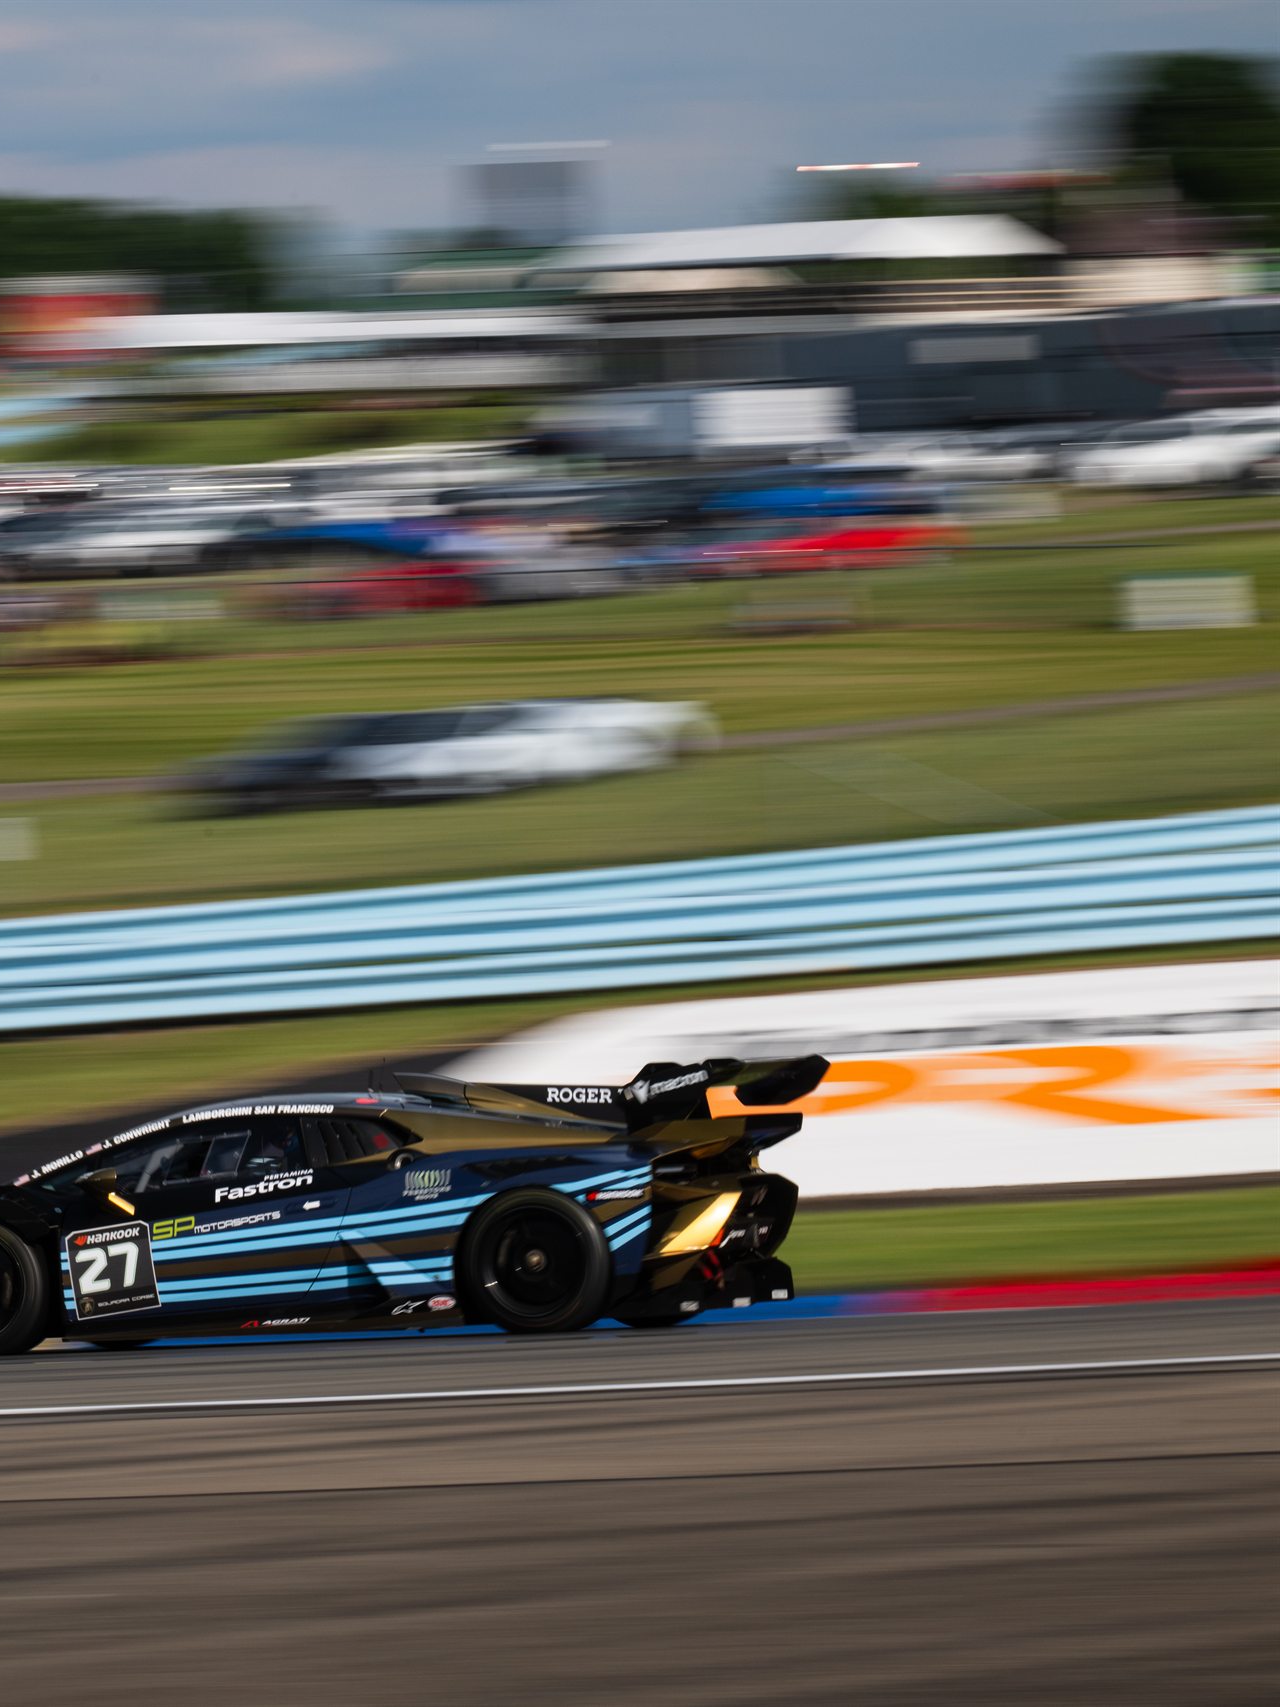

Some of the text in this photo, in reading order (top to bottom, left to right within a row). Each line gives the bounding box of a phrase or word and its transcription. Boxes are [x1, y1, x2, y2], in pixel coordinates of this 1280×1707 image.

[546, 1087, 612, 1104] ROGER
[182, 1104, 335, 1124] LAMBORGHINI SAN FRANCISCO
[264, 1169, 313, 1181] PERTAMINA
[214, 1175, 313, 1203] Fastron
[152, 1210, 281, 1240] SP MOTORSPORTS
[75, 1241, 139, 1295] 27
